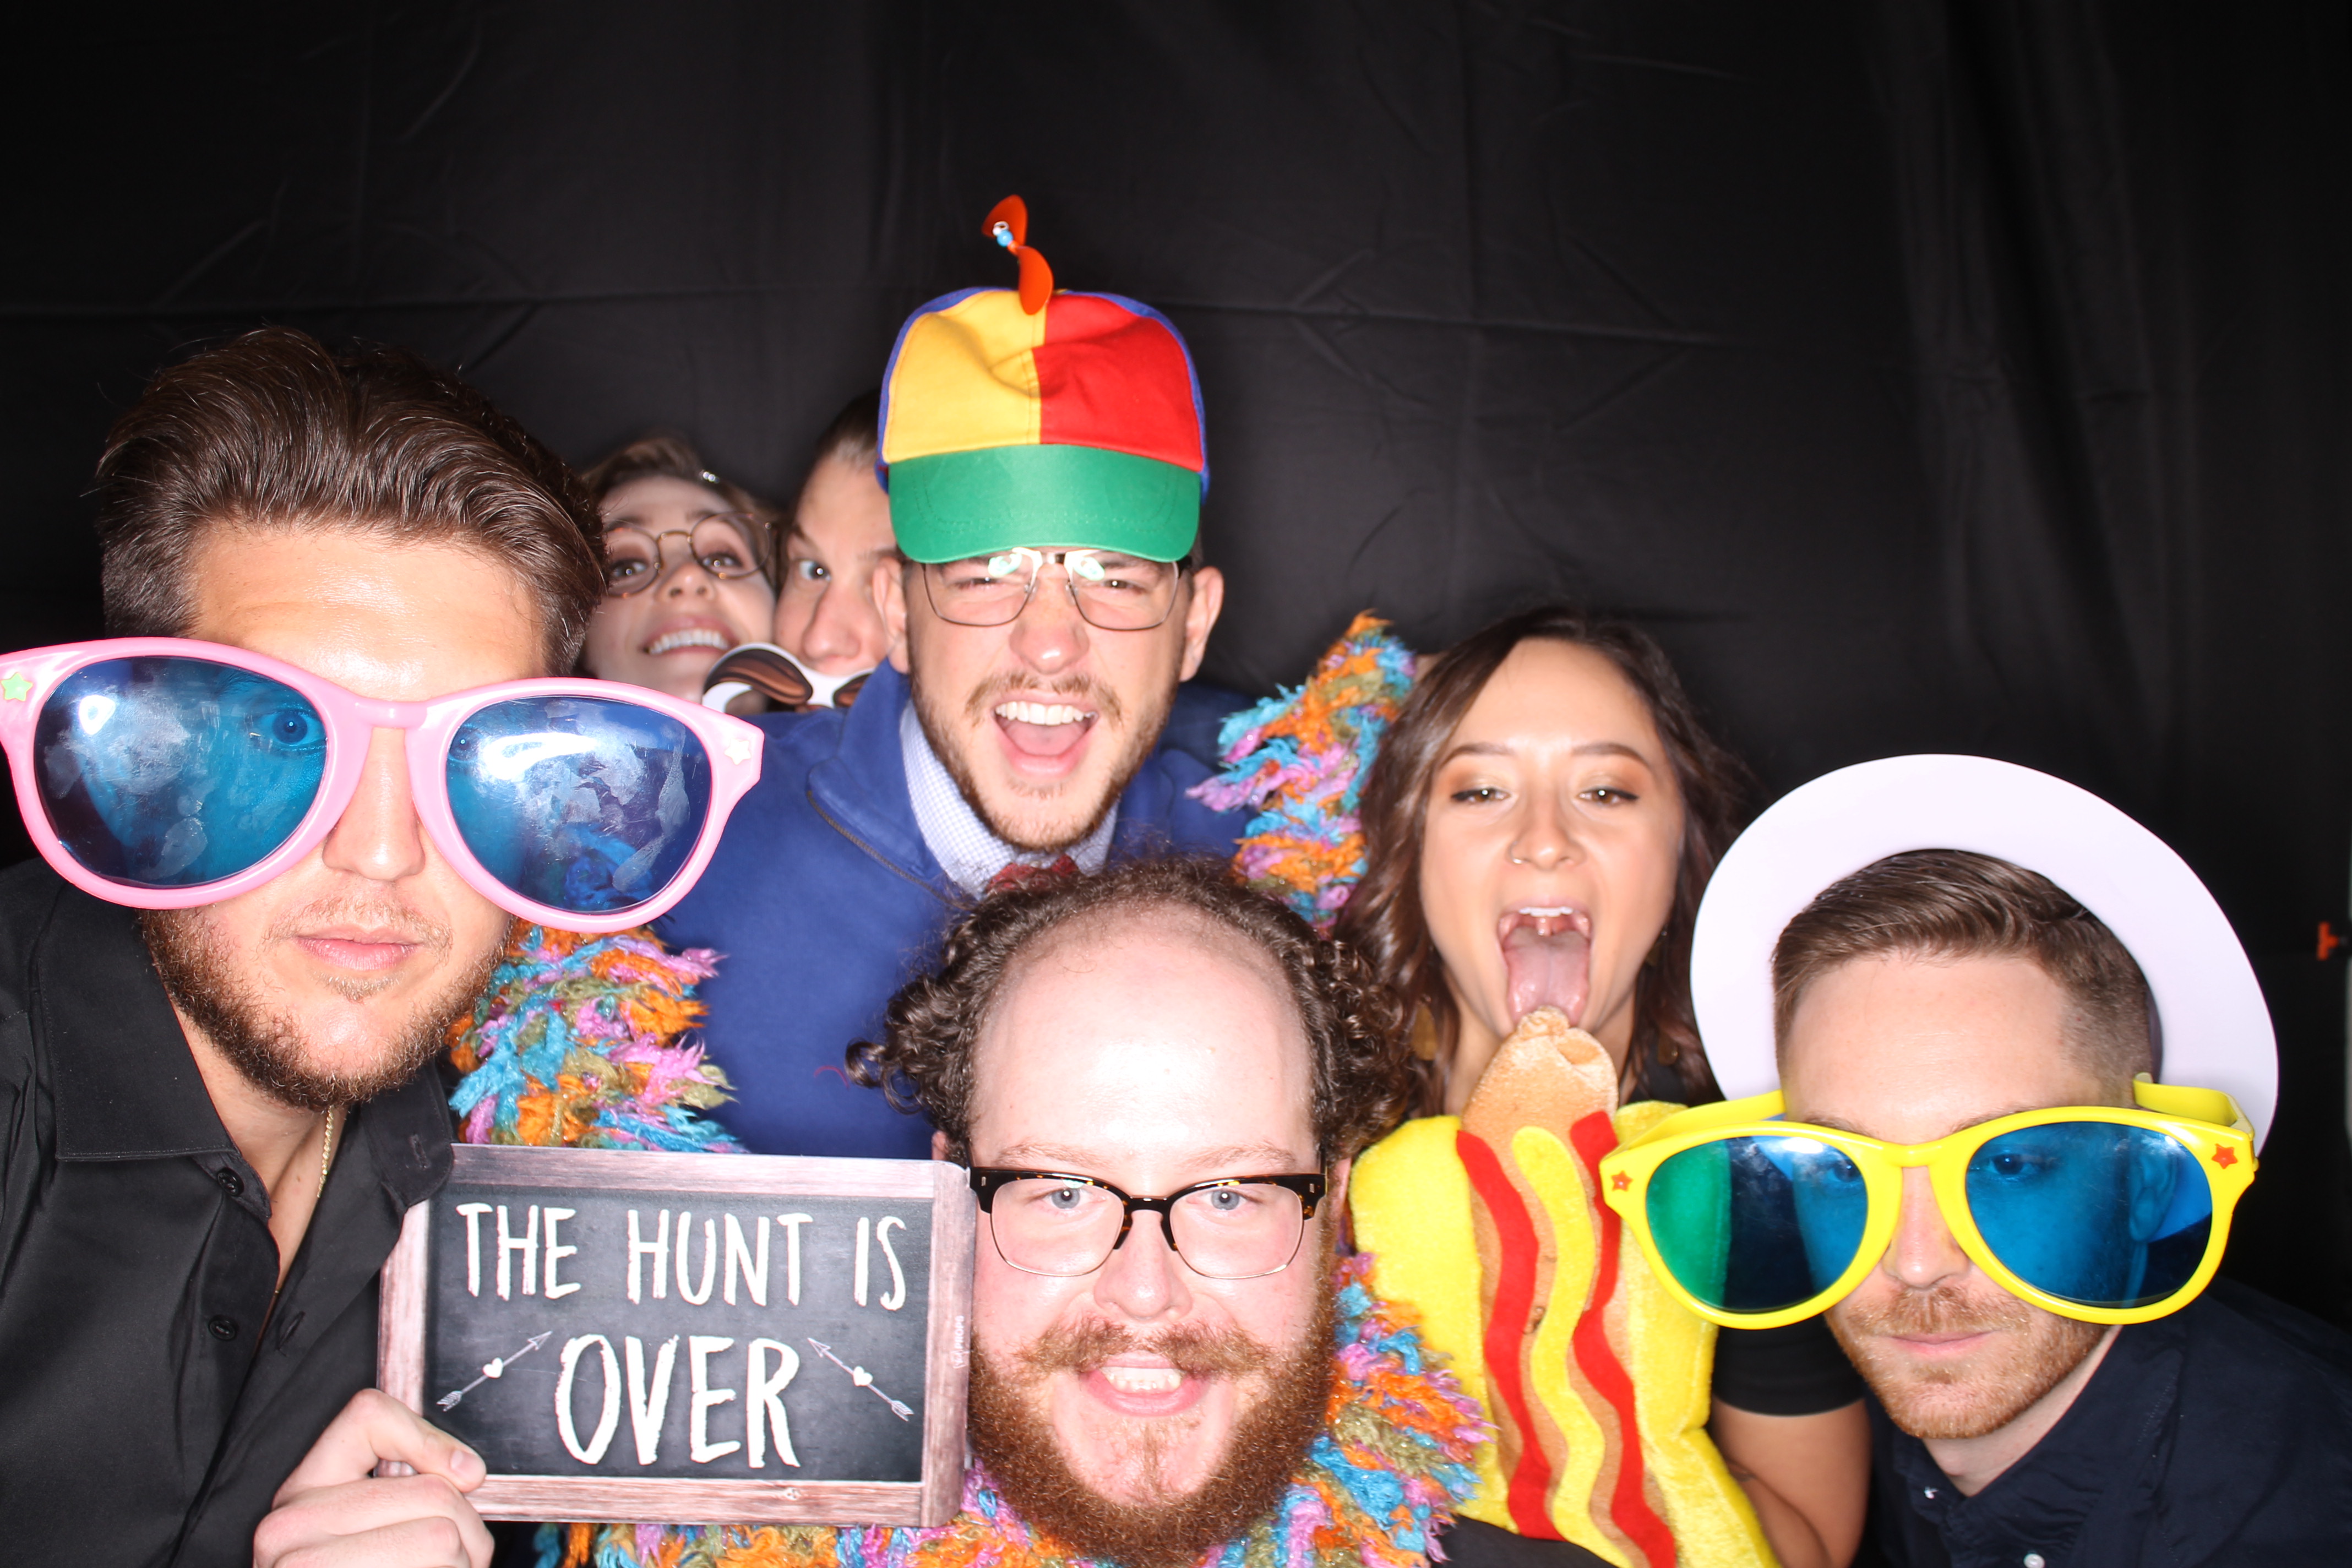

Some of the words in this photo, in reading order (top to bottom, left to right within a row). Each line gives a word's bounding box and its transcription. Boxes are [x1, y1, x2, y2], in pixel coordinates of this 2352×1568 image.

[456, 1202, 581, 1301] THE
[627, 1208, 814, 1307] HUNT
[853, 1215, 907, 1311] IS
[954, 1315, 965, 1349] PROPS
[554, 1333, 801, 1469] OVER
